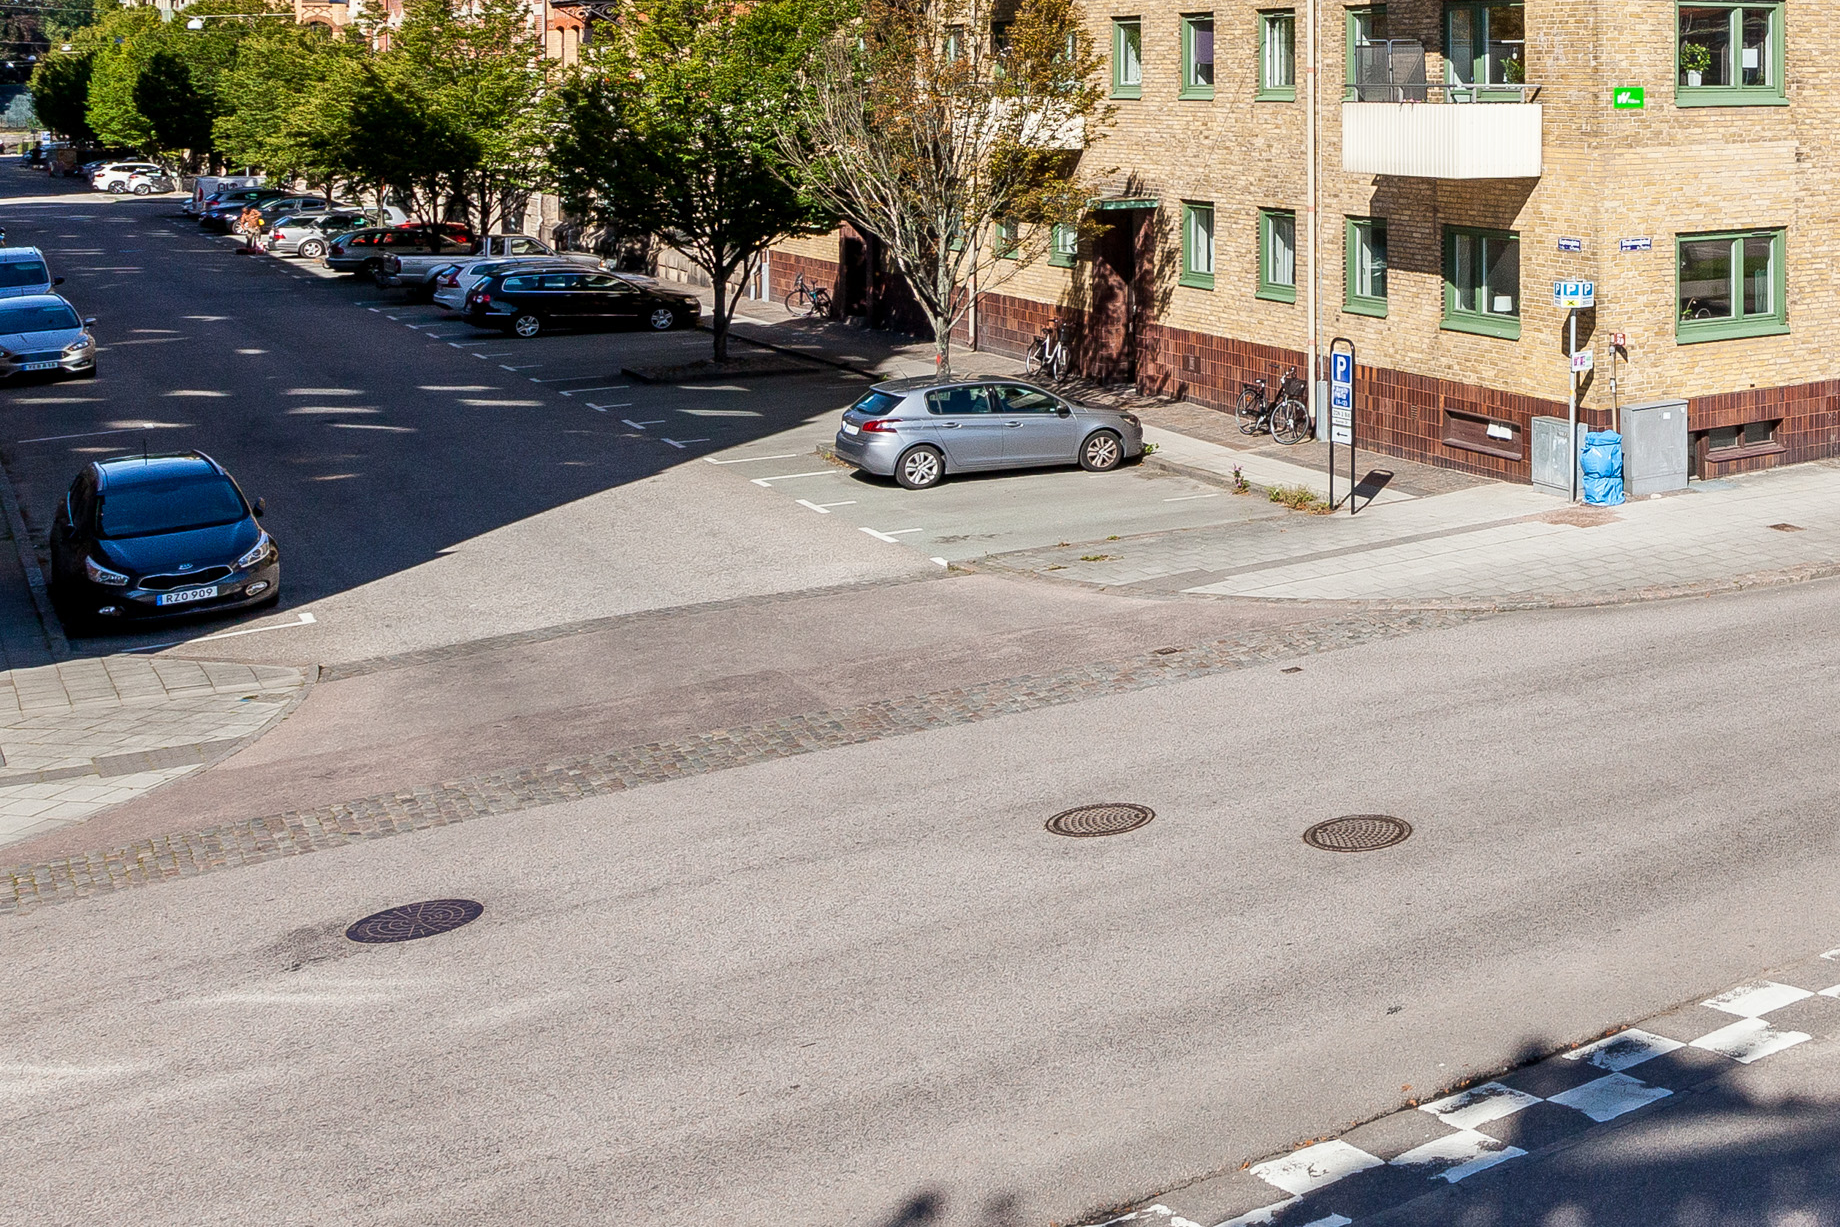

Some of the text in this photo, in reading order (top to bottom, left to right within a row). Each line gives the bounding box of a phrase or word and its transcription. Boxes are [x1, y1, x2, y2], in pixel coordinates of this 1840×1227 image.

[1566, 284, 1577, 295] P
[1583, 284, 1592, 295] P
[1336, 356, 1347, 381] P
[191, 588, 213, 600] 909
